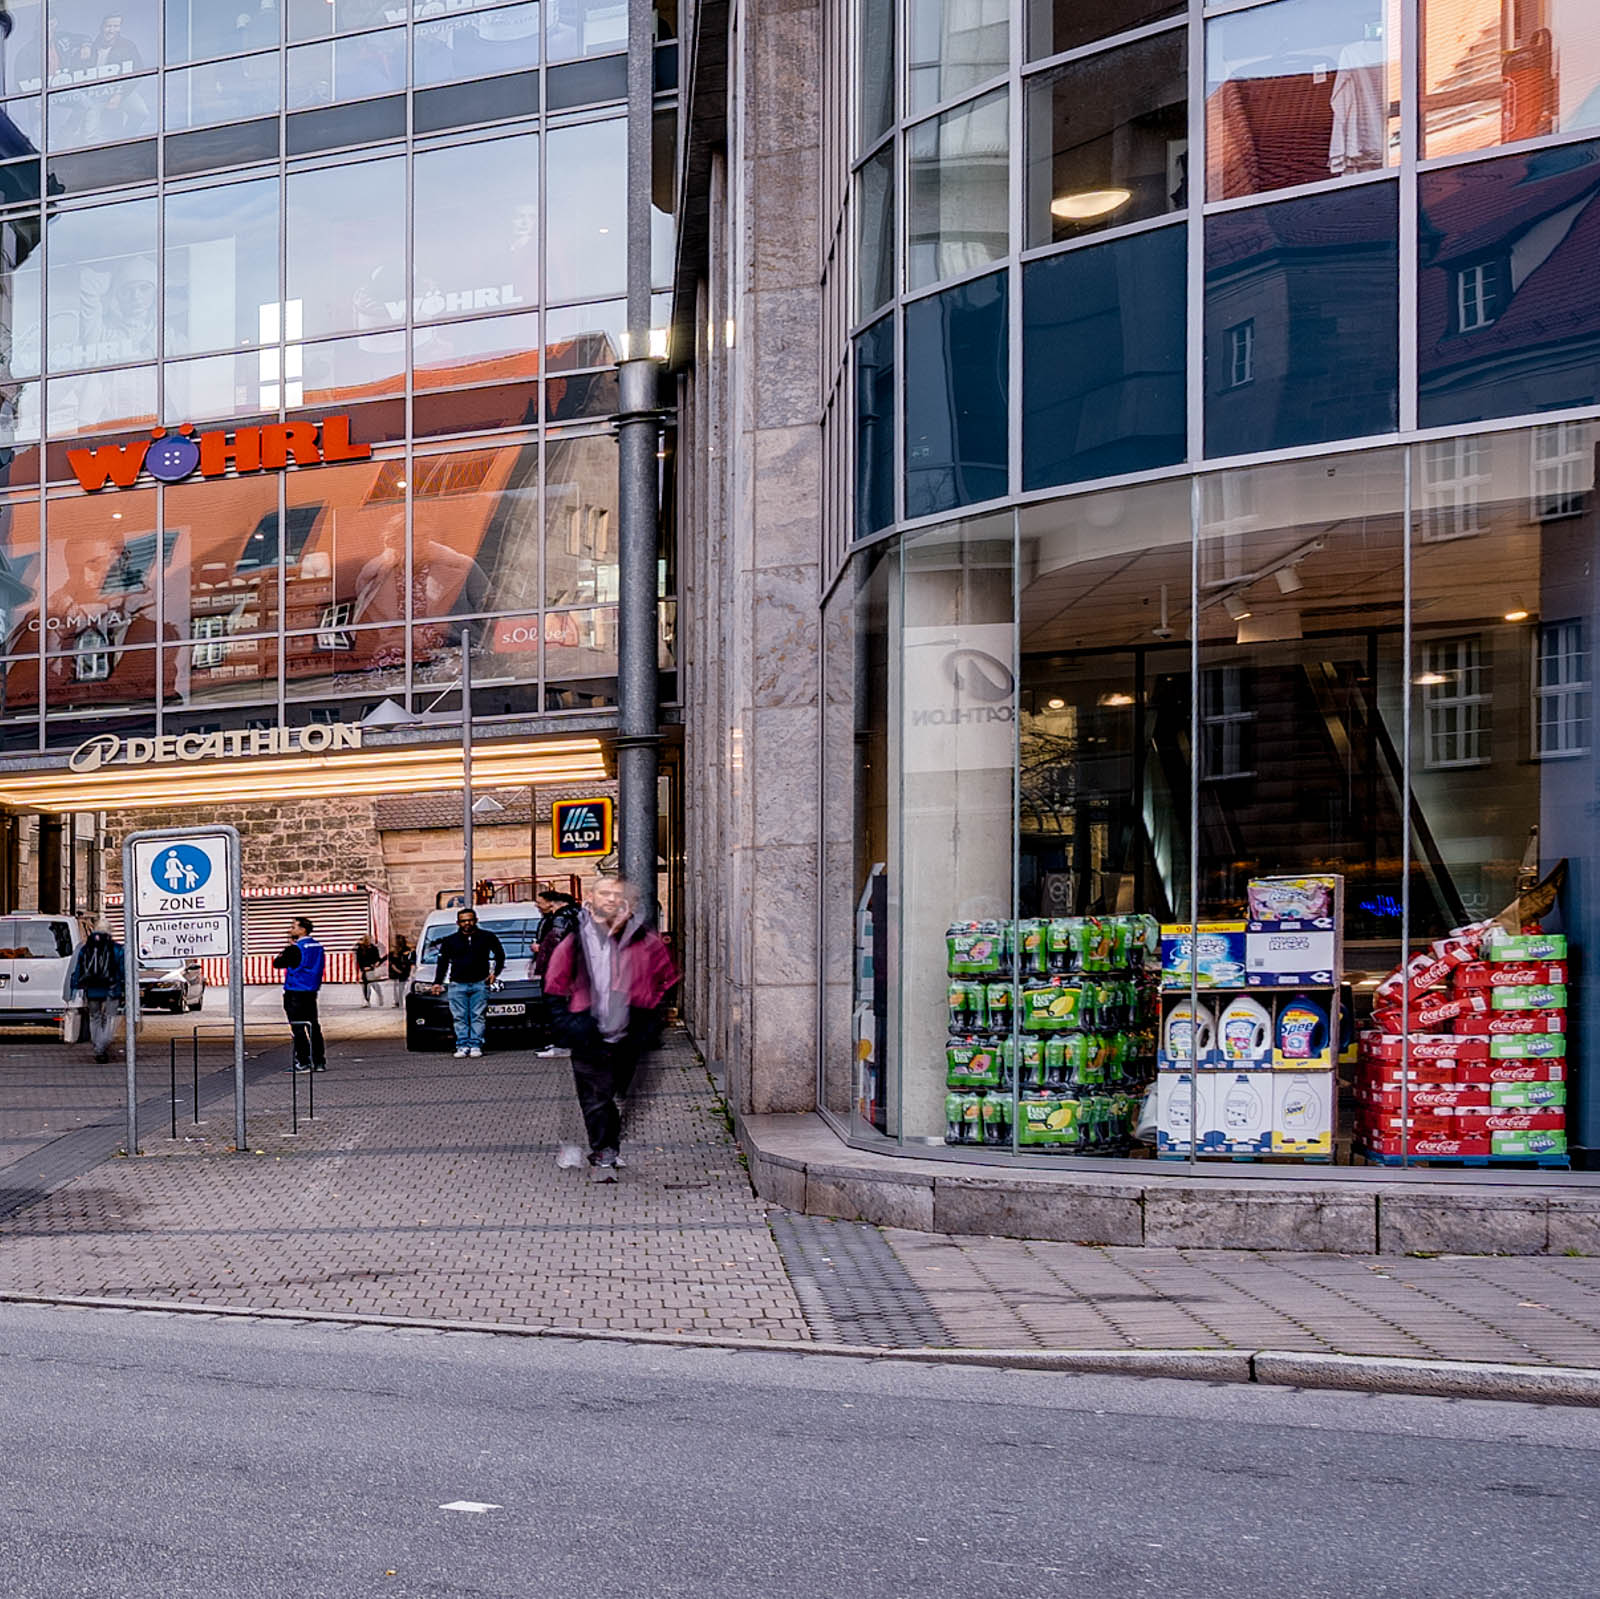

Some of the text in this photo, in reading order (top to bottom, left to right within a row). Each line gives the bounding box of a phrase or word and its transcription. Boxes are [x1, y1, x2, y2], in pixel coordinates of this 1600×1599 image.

[384, 283, 523, 321] WÖHRL
[66, 414, 372, 492] WÖHRL
[501, 624, 568, 644] s.Olver
[126, 721, 363, 765] DECATHLON
[562, 830, 601, 843] ALDI
[159, 896, 206, 911] ZONE
[146, 920, 220, 932] Anlieferung
[152, 933, 213, 945] Fa. Wöhrl
[172, 946, 195, 956] frei
[1281, 1022, 1313, 1035] Spee
